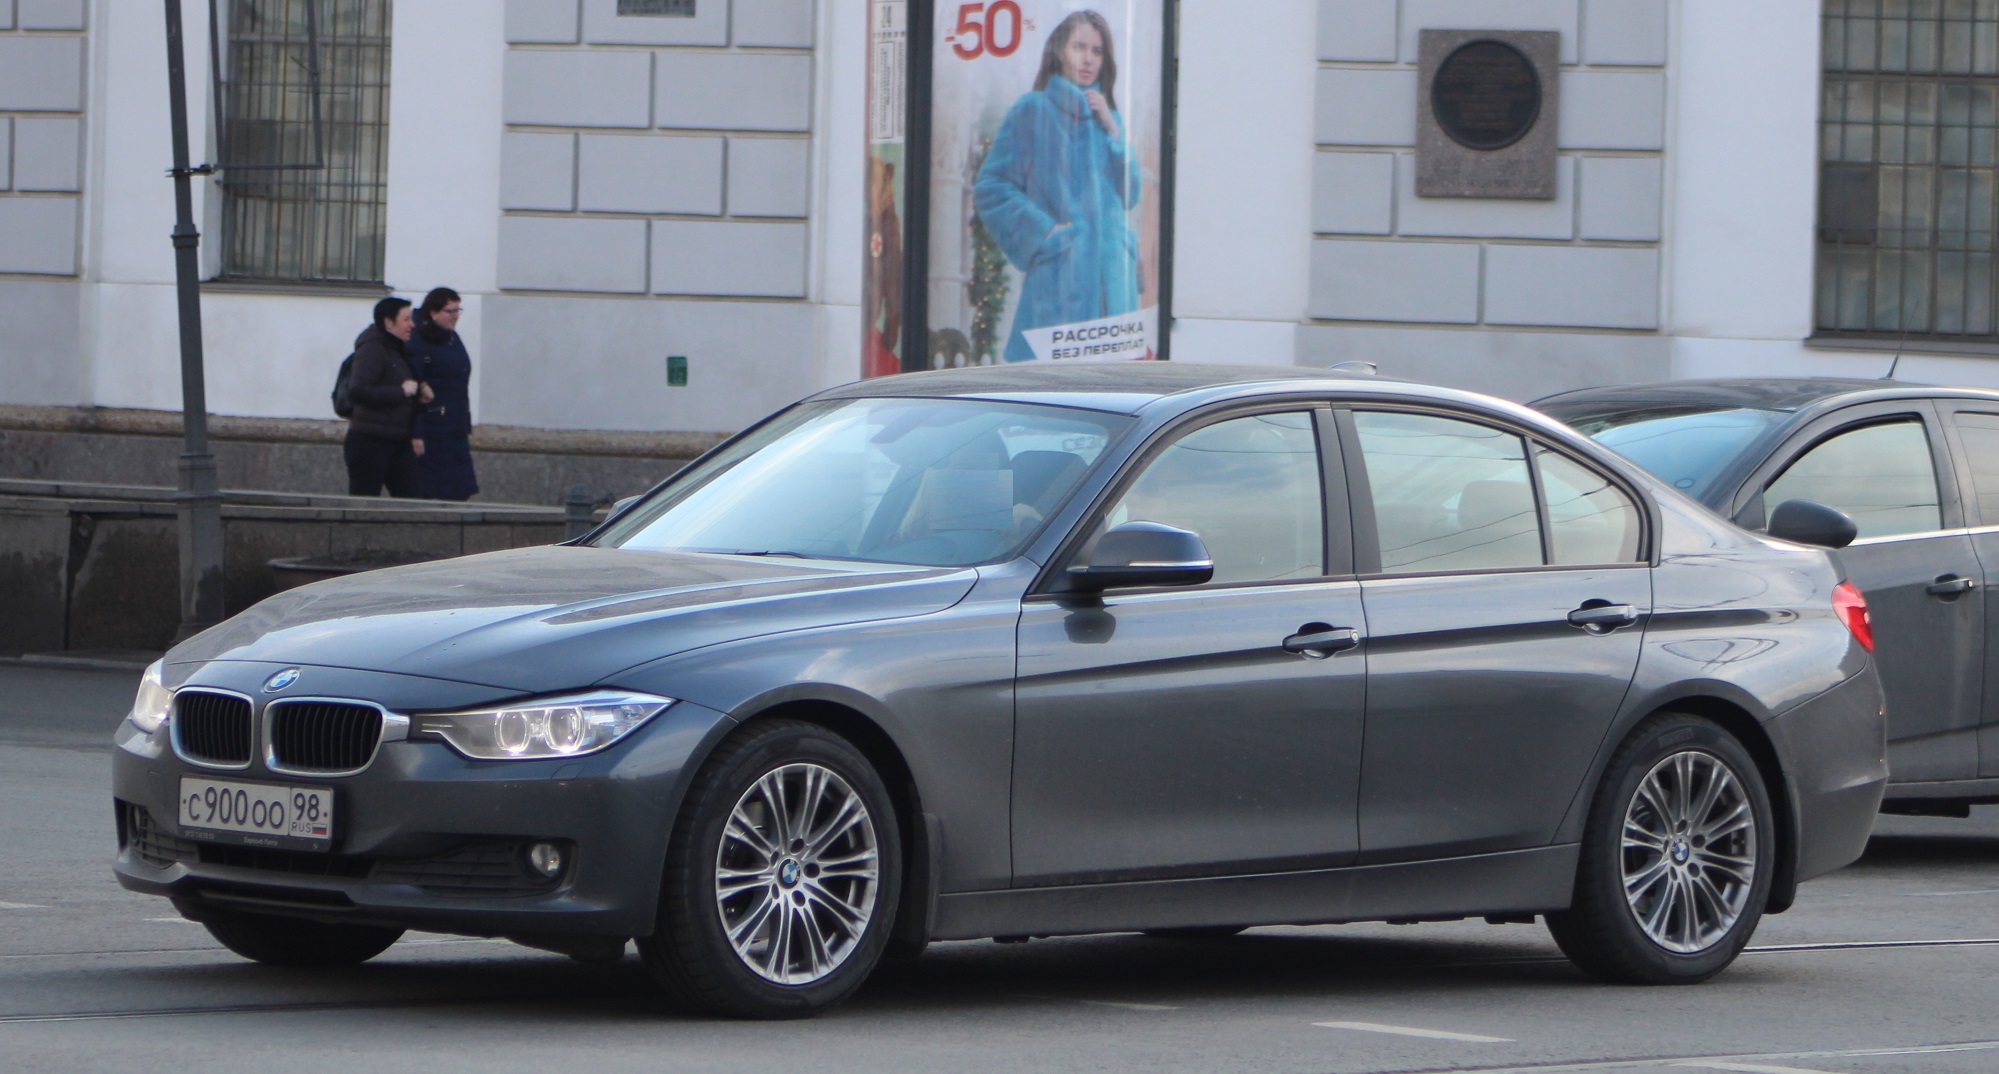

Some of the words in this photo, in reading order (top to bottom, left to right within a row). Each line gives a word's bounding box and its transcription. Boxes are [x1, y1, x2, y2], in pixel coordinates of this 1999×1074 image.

[1052, 321, 1145, 344] РАССРОЧКА
[1052, 347, 1080, 360] БЕЗ
[1083, 338, 1145, 356] ПЕРЕПЛАТ
[294, 792, 320, 822] 98
[291, 821, 311, 834] RUS
